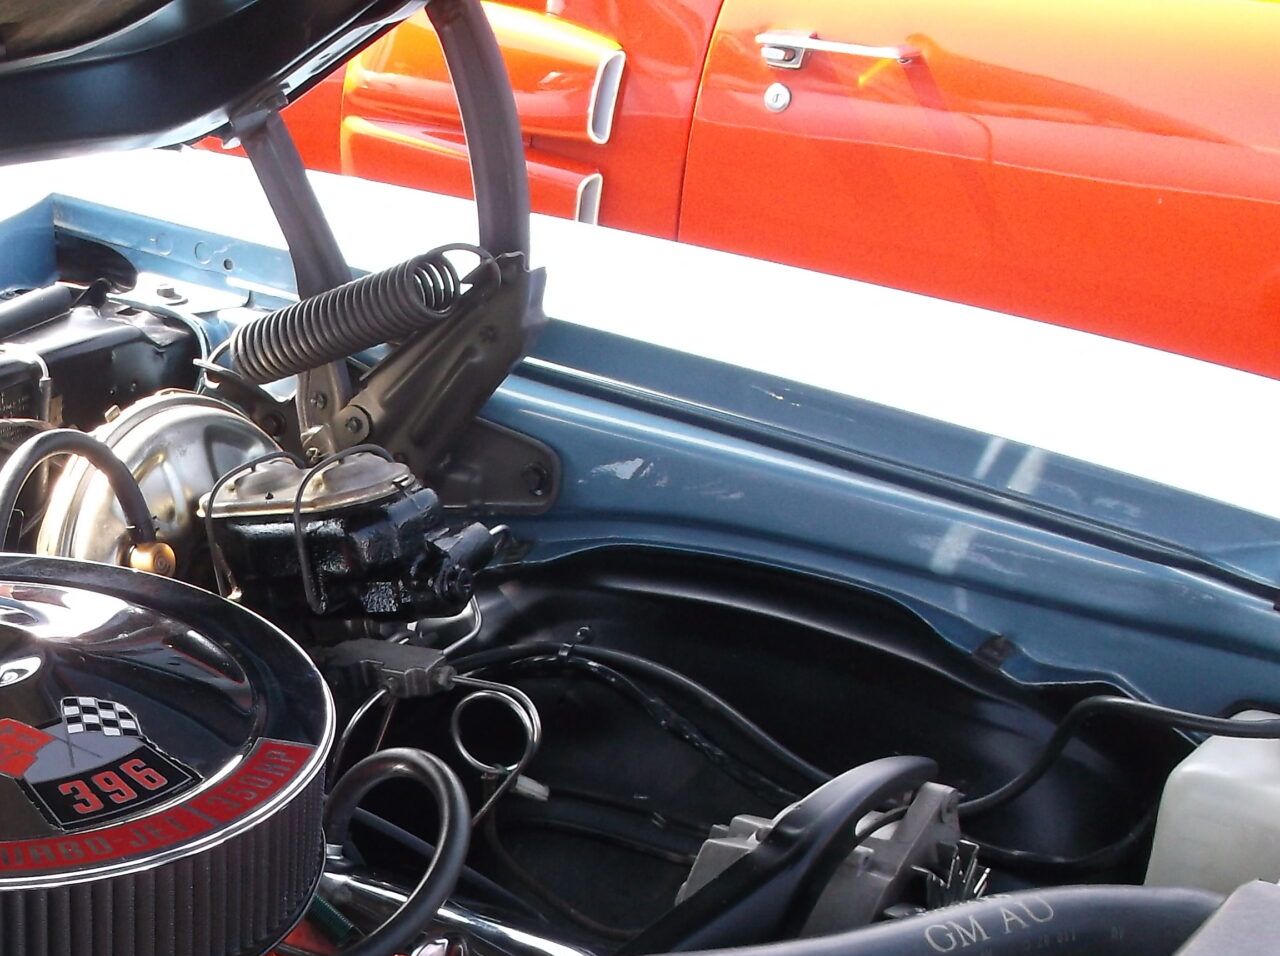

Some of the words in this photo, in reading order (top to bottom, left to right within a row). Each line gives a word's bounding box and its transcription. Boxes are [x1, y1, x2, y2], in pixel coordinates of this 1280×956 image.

[58, 758, 168, 814] 396
[924, 915, 991, 953] GM
[1000, 896, 1054, 934] AU
